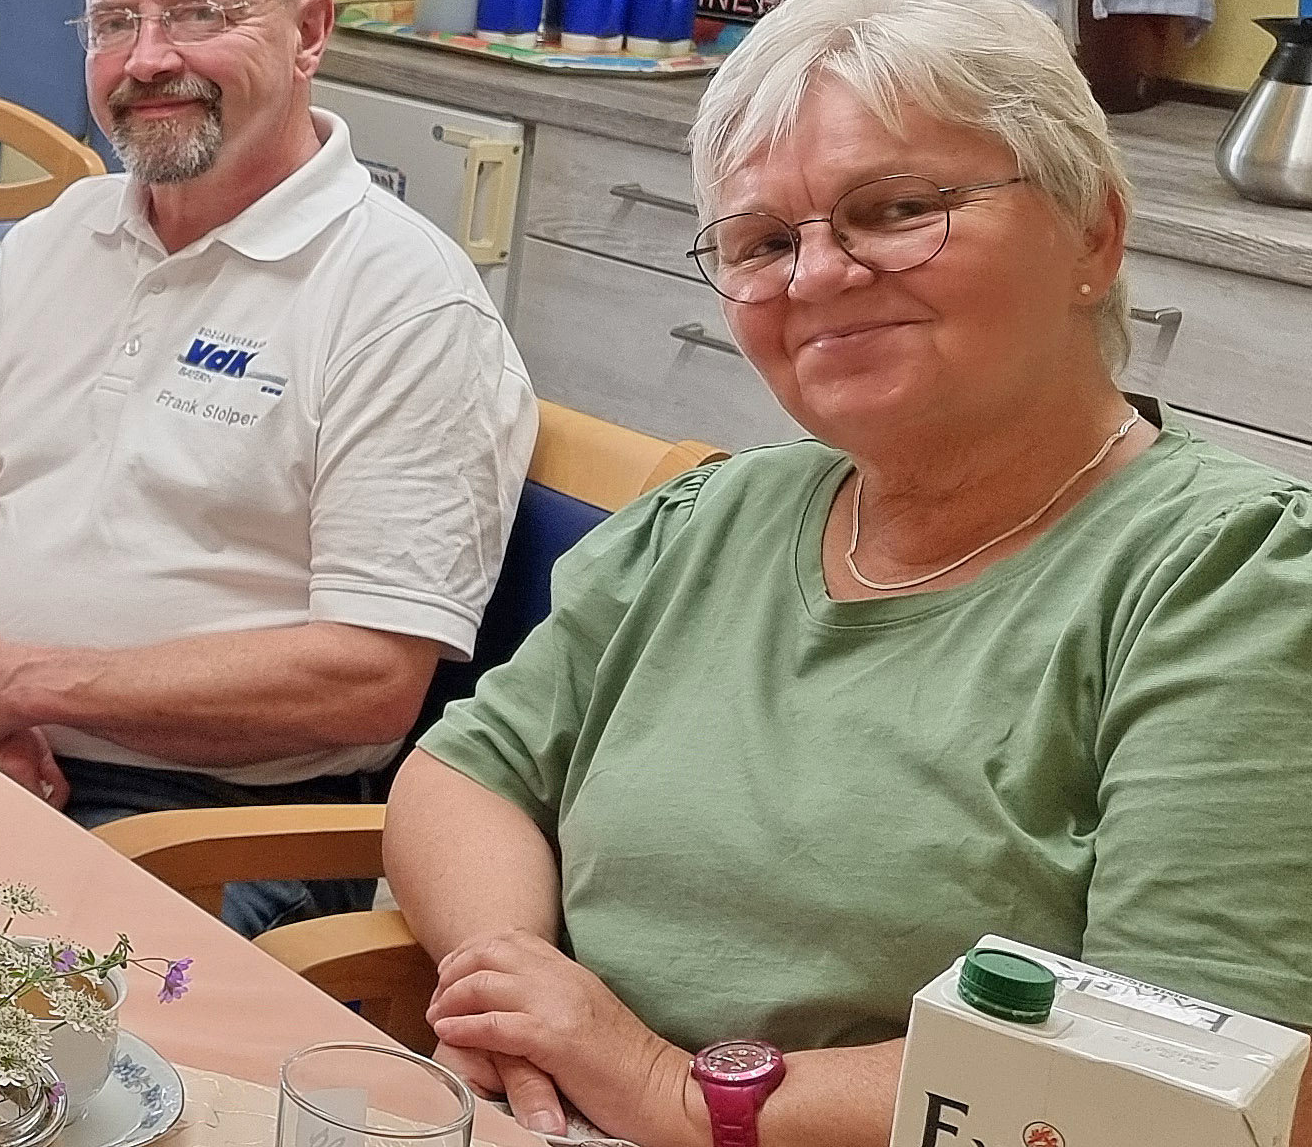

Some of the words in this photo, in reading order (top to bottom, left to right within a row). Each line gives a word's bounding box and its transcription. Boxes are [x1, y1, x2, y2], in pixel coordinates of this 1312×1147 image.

[185, 338, 259, 378] VdK
[157, 390, 198, 416] Frank
[203, 404, 258, 427] Stolper
